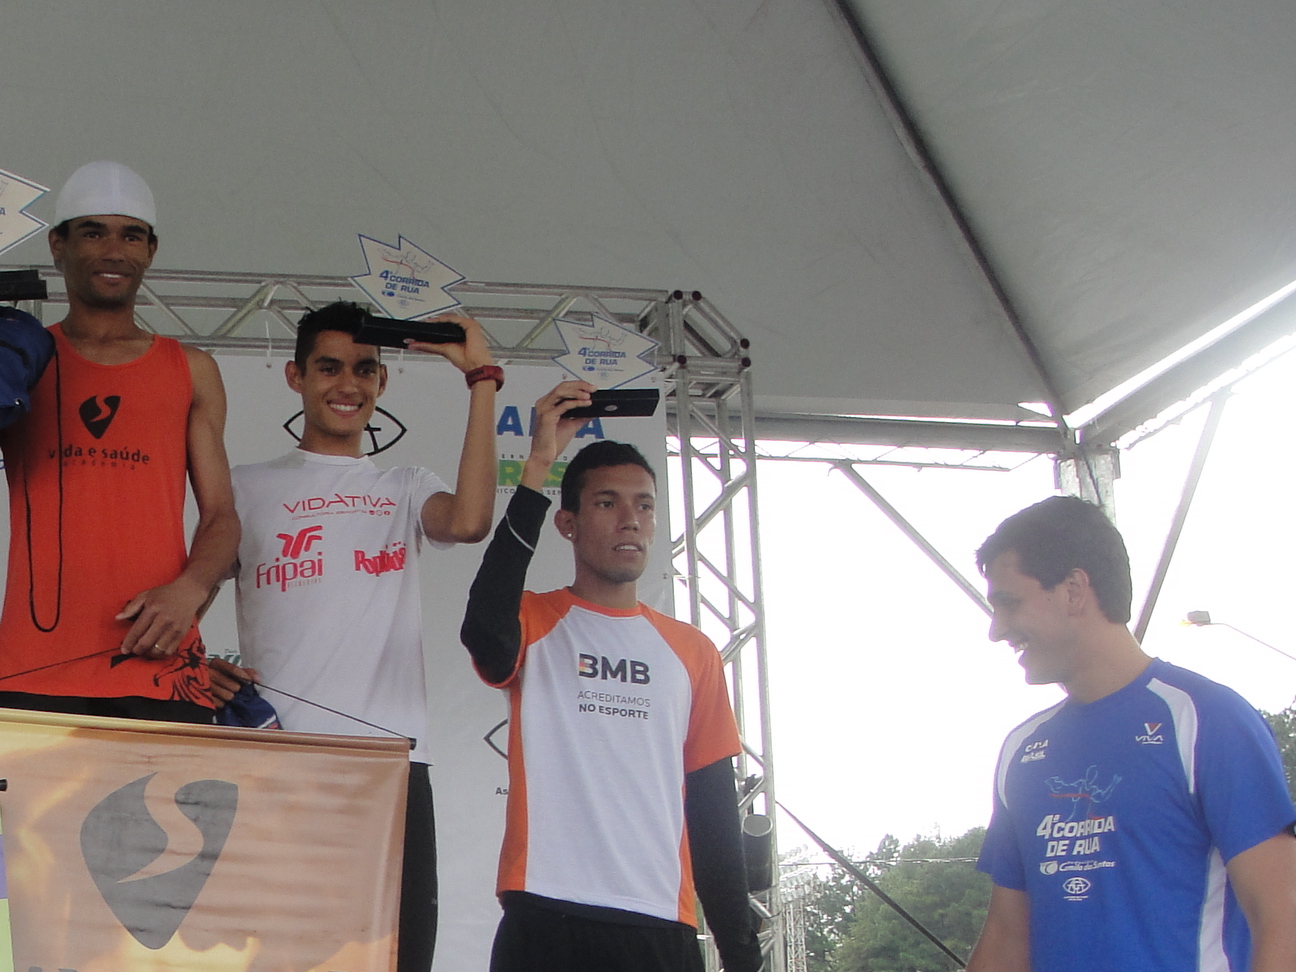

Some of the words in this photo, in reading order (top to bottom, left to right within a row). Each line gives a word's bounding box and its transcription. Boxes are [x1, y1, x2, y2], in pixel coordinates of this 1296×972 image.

[385, 282, 397, 291] DE
[400, 286, 420, 294] RUA
[389, 275, 429, 288] CORRIDA
[49, 444, 82, 460] vda
[88, 447, 97, 457] e
[101, 447, 150, 464] saúde
[282, 493, 396, 513] VIDATIVA
[579, 653, 650, 685] BMB
[577, 690, 650, 708] ACREDITAMOS
[579, 703, 596, 713] NO
[598, 705, 649, 720] ESPORTE
[1052, 816, 1116, 838] CORRIDA
[1046, 840, 1070, 857] DE
[1072, 836, 1100, 855] RUA
